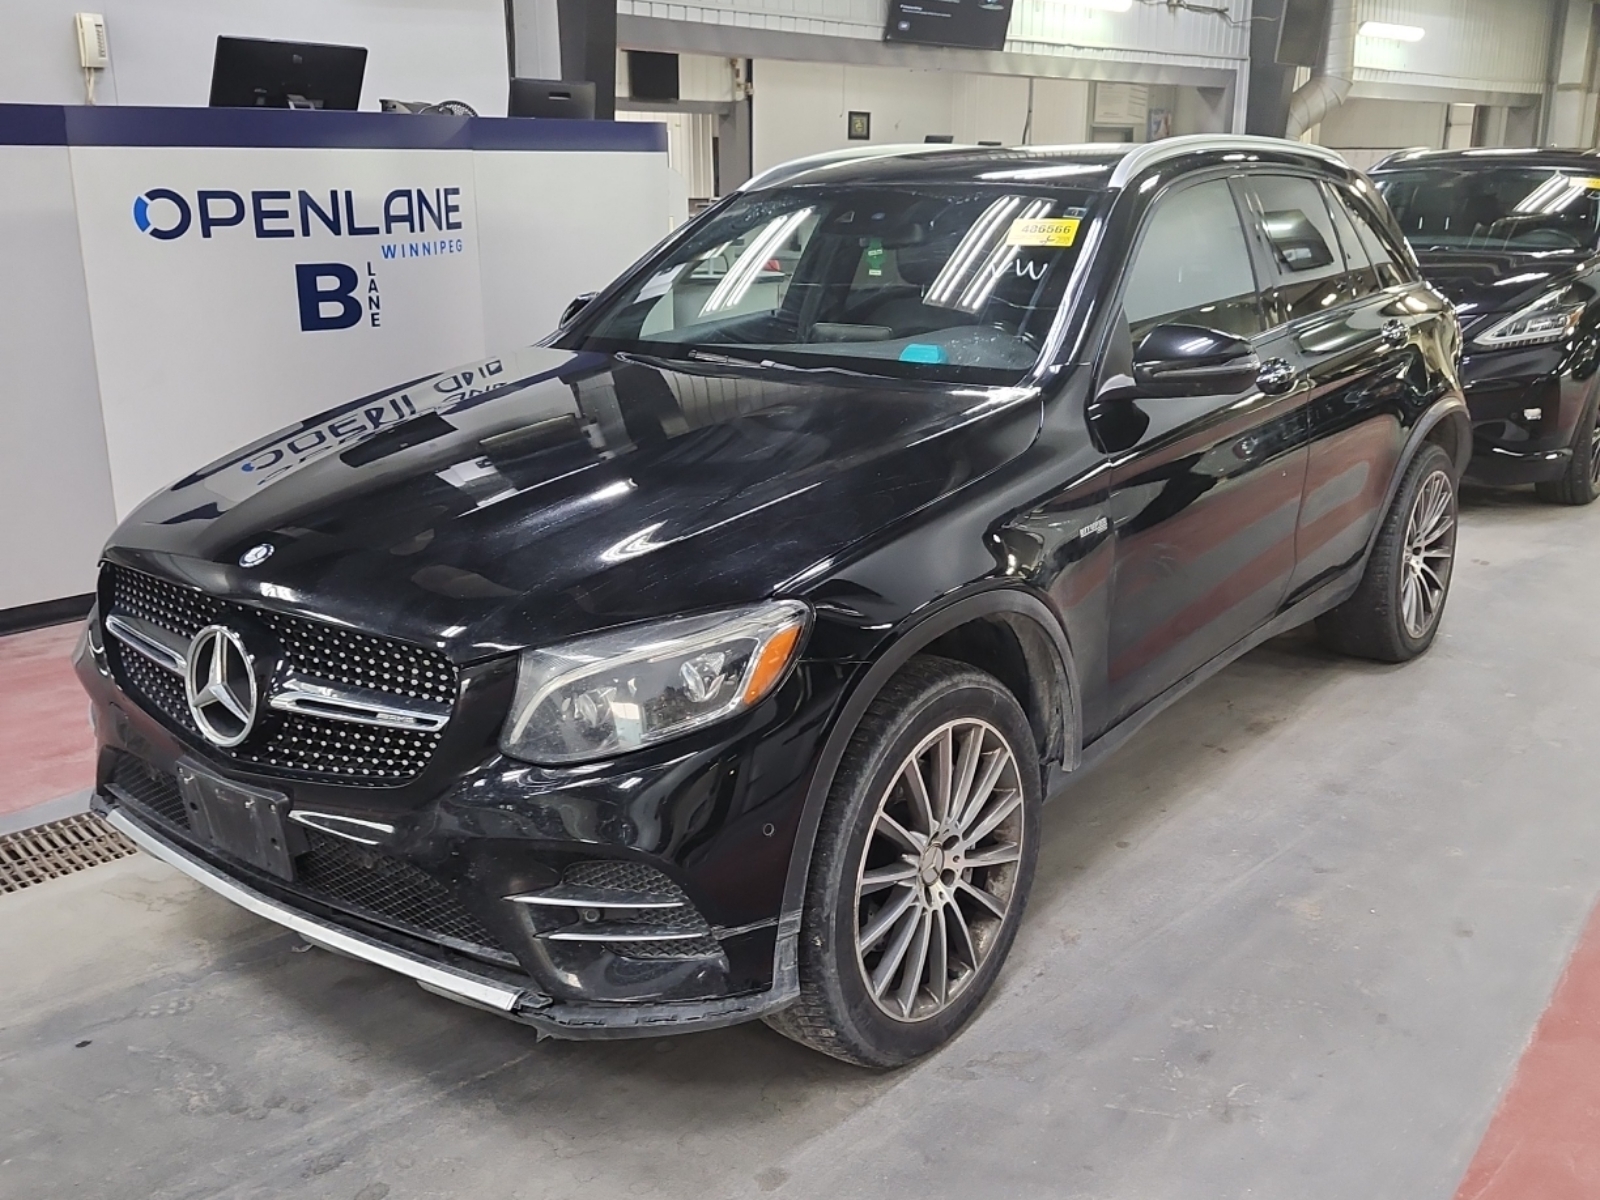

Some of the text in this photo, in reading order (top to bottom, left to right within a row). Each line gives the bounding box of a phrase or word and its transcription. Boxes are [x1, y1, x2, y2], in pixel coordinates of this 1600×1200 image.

[133, 187, 463, 240] OPENLANE
[381, 239, 463, 259] WINNIPEG
[295, 261, 381, 332] B LANE
